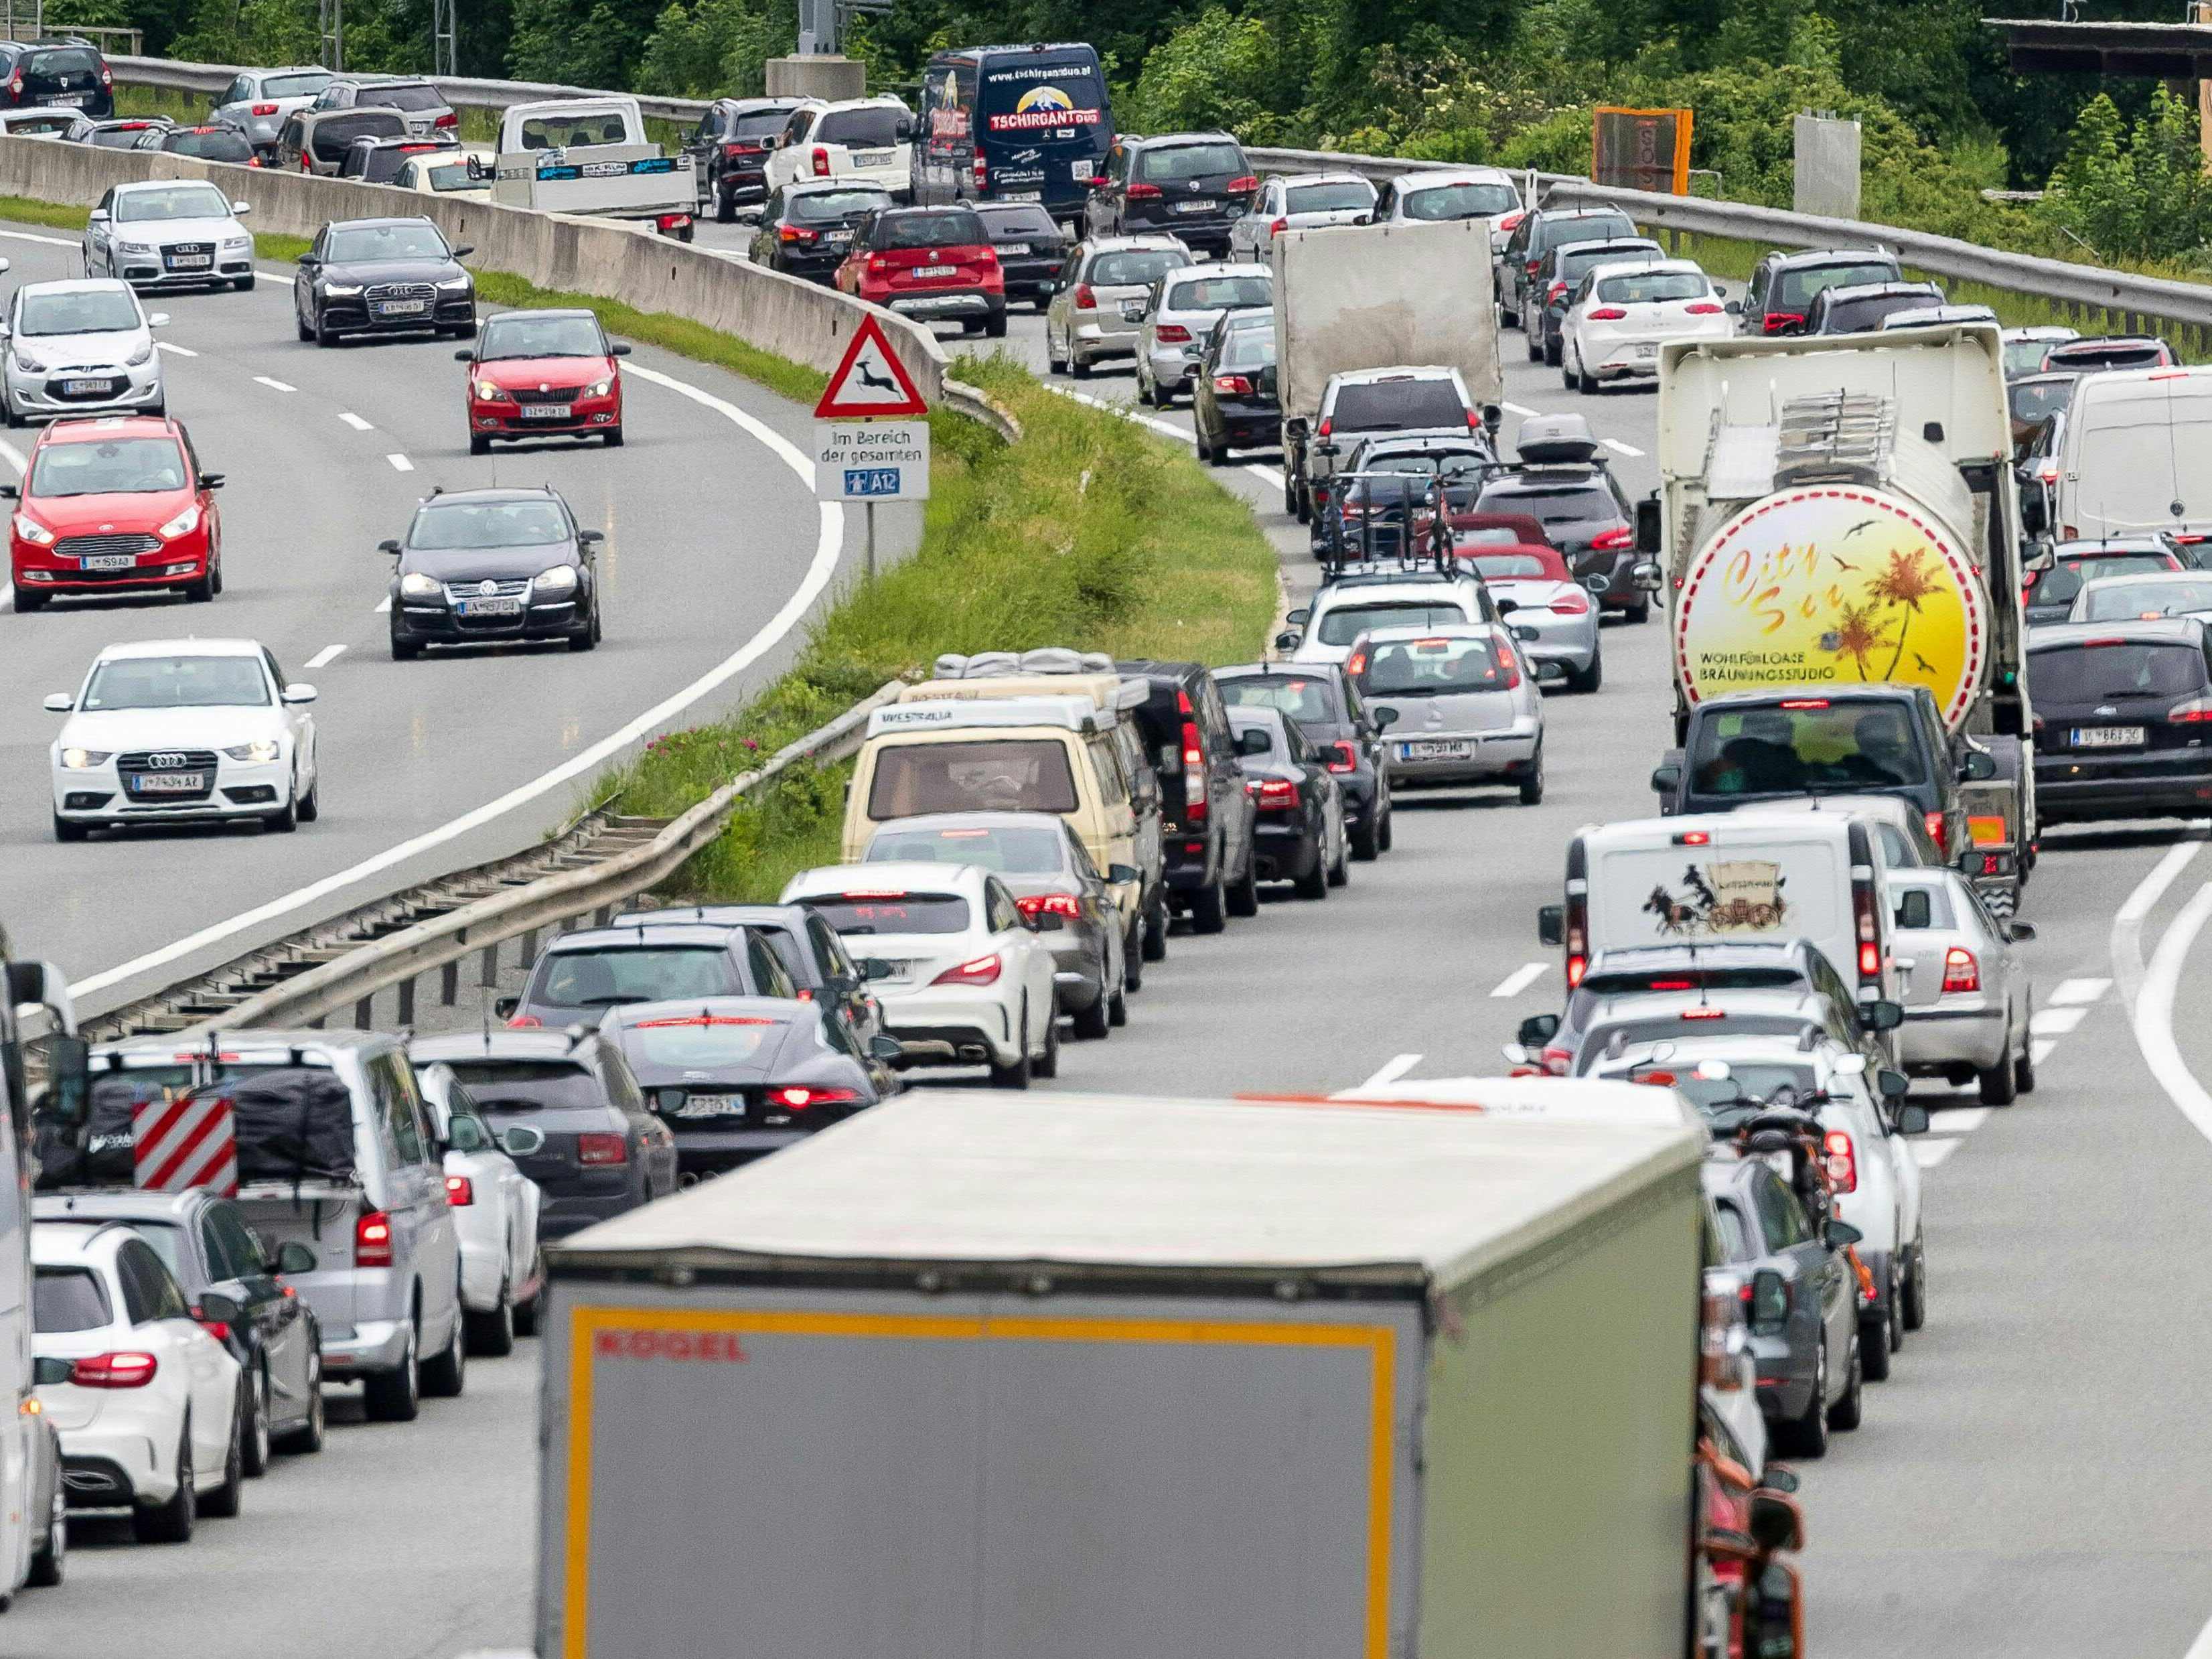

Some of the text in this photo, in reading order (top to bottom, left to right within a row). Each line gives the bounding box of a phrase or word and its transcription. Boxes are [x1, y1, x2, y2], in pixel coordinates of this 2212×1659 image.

[990, 111, 1074, 129] TSCHIRGANT
[832, 429, 911, 445] Im Bereich
[821, 448, 922, 465] der gesamten
[871, 473, 897, 491] A12
